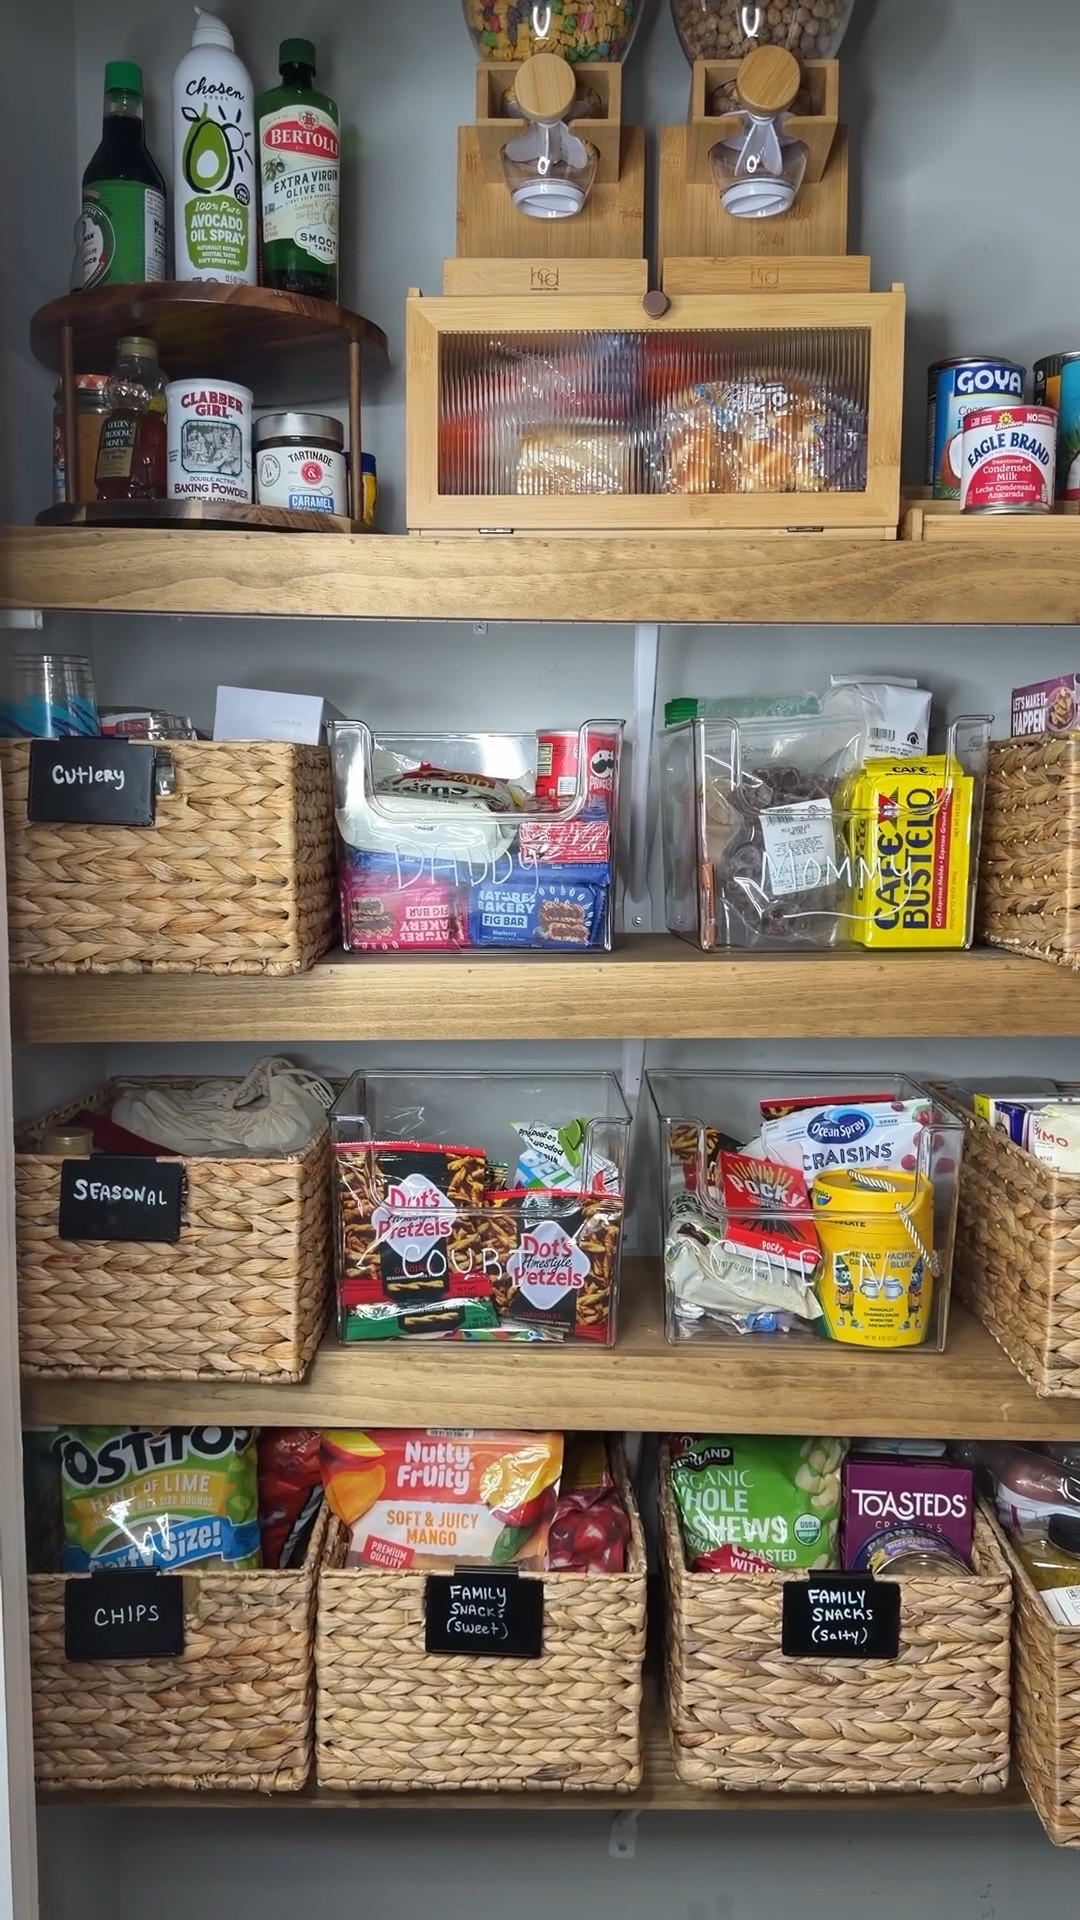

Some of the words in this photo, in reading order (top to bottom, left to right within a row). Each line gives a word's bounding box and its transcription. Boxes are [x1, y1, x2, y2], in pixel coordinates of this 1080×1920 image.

[186, 76, 244, 101] Chosen
[271, 129, 338, 156] BERTOLLI
[274, 173, 309, 194] EXTRA
[311, 169, 338, 182] VIRGIN
[286, 184, 316, 198] OLIVE
[318, 182, 331, 192] OIL
[195, 202, 218, 212] 100%
[220, 201, 242, 215] Pure
[191, 213, 243, 231] AVOCADO
[190, 229, 208, 242] OIL
[209, 229, 246, 246] SPRAY
[315, 244, 334, 255] TASTE
[957, 369, 1022, 393] GOYA
[181, 391, 244, 415] CLABBER
[195, 404, 230, 419] GIRL
[1026, 413, 1038, 421] NO
[288, 450, 333, 467] TARTINADE
[968, 433, 1006, 468] EAGLE
[1009, 432, 1050, 466] BRAND
[983, 463, 1032, 474] Condensed
[996, 472, 1018, 481] Milk
[216, 477, 237, 486] ACTING
[975, 486, 994, 494] Leche
[995, 483, 1036, 492] Condensada
[174, 483, 209, 494] BAKING
[212, 483, 249, 499] POWDER
[292, 495, 333, 509] CARAMEL
[1013, 696, 1025, 711] LET'S
[1025, 692, 1040, 709] MAKE
[1040, 692, 1046, 706] IT
[1013, 708, 1046, 736] HAPPEN
[903, 788, 935, 929] BUSTELO
[478, 901, 536, 914] BAKERY
[936, 887, 944, 912] Espresso
[409, 907, 430, 917] BAR
[484, 915, 501, 925] FIG
[502, 916, 525, 927] BAR
[935, 913, 943, 927] Café
[400, 919, 450, 932] AKERY
[492, 929, 517, 938] Blueberry
[811, 1124, 839, 1138] Ocean
[840, 1120, 866, 1139] Spray
[803, 1142, 892, 1172] CRAISINS
[73, 1178, 168, 1206] SEASONAL
[379, 1216, 452, 1239] Pretzels
[522, 1235, 573, 1258] Dot's
[402, 1244, 534, 1280] COURT
[891, 1261, 912, 1269] BLUE
[523, 1311, 562, 1320] ORIGINAL
[405, 1440, 471, 1471] Nutty
[677, 1469, 755, 1489] RGANIC
[92, 1486, 137, 1511] HINT
[142, 1479, 159, 1493] OF
[164, 1475, 211, 1493] LIME
[159, 1497, 177, 1506] SIZE
[180, 1496, 213, 1507] ROUNDS
[851, 1489, 967, 1521] TOASTEDS
[387, 1509, 422, 1526] SOFT
[425, 1511, 434, 1527] &
[438, 1512, 479, 1529] JUICY
[800, 1521, 817, 1529] USDA
[161, 1520, 222, 1562] Size!
[406, 1528, 457, 1547] MANGO
[370, 1551, 404, 1569] QUALITY
[371, 1541, 408, 1561] PREMIUM
[450, 1586, 507, 1607] FAMILY
[808, 1589, 866, 1607] FAMILY
[94, 1604, 160, 1627] CHIPS
[812, 1608, 873, 1622] SNACKS
